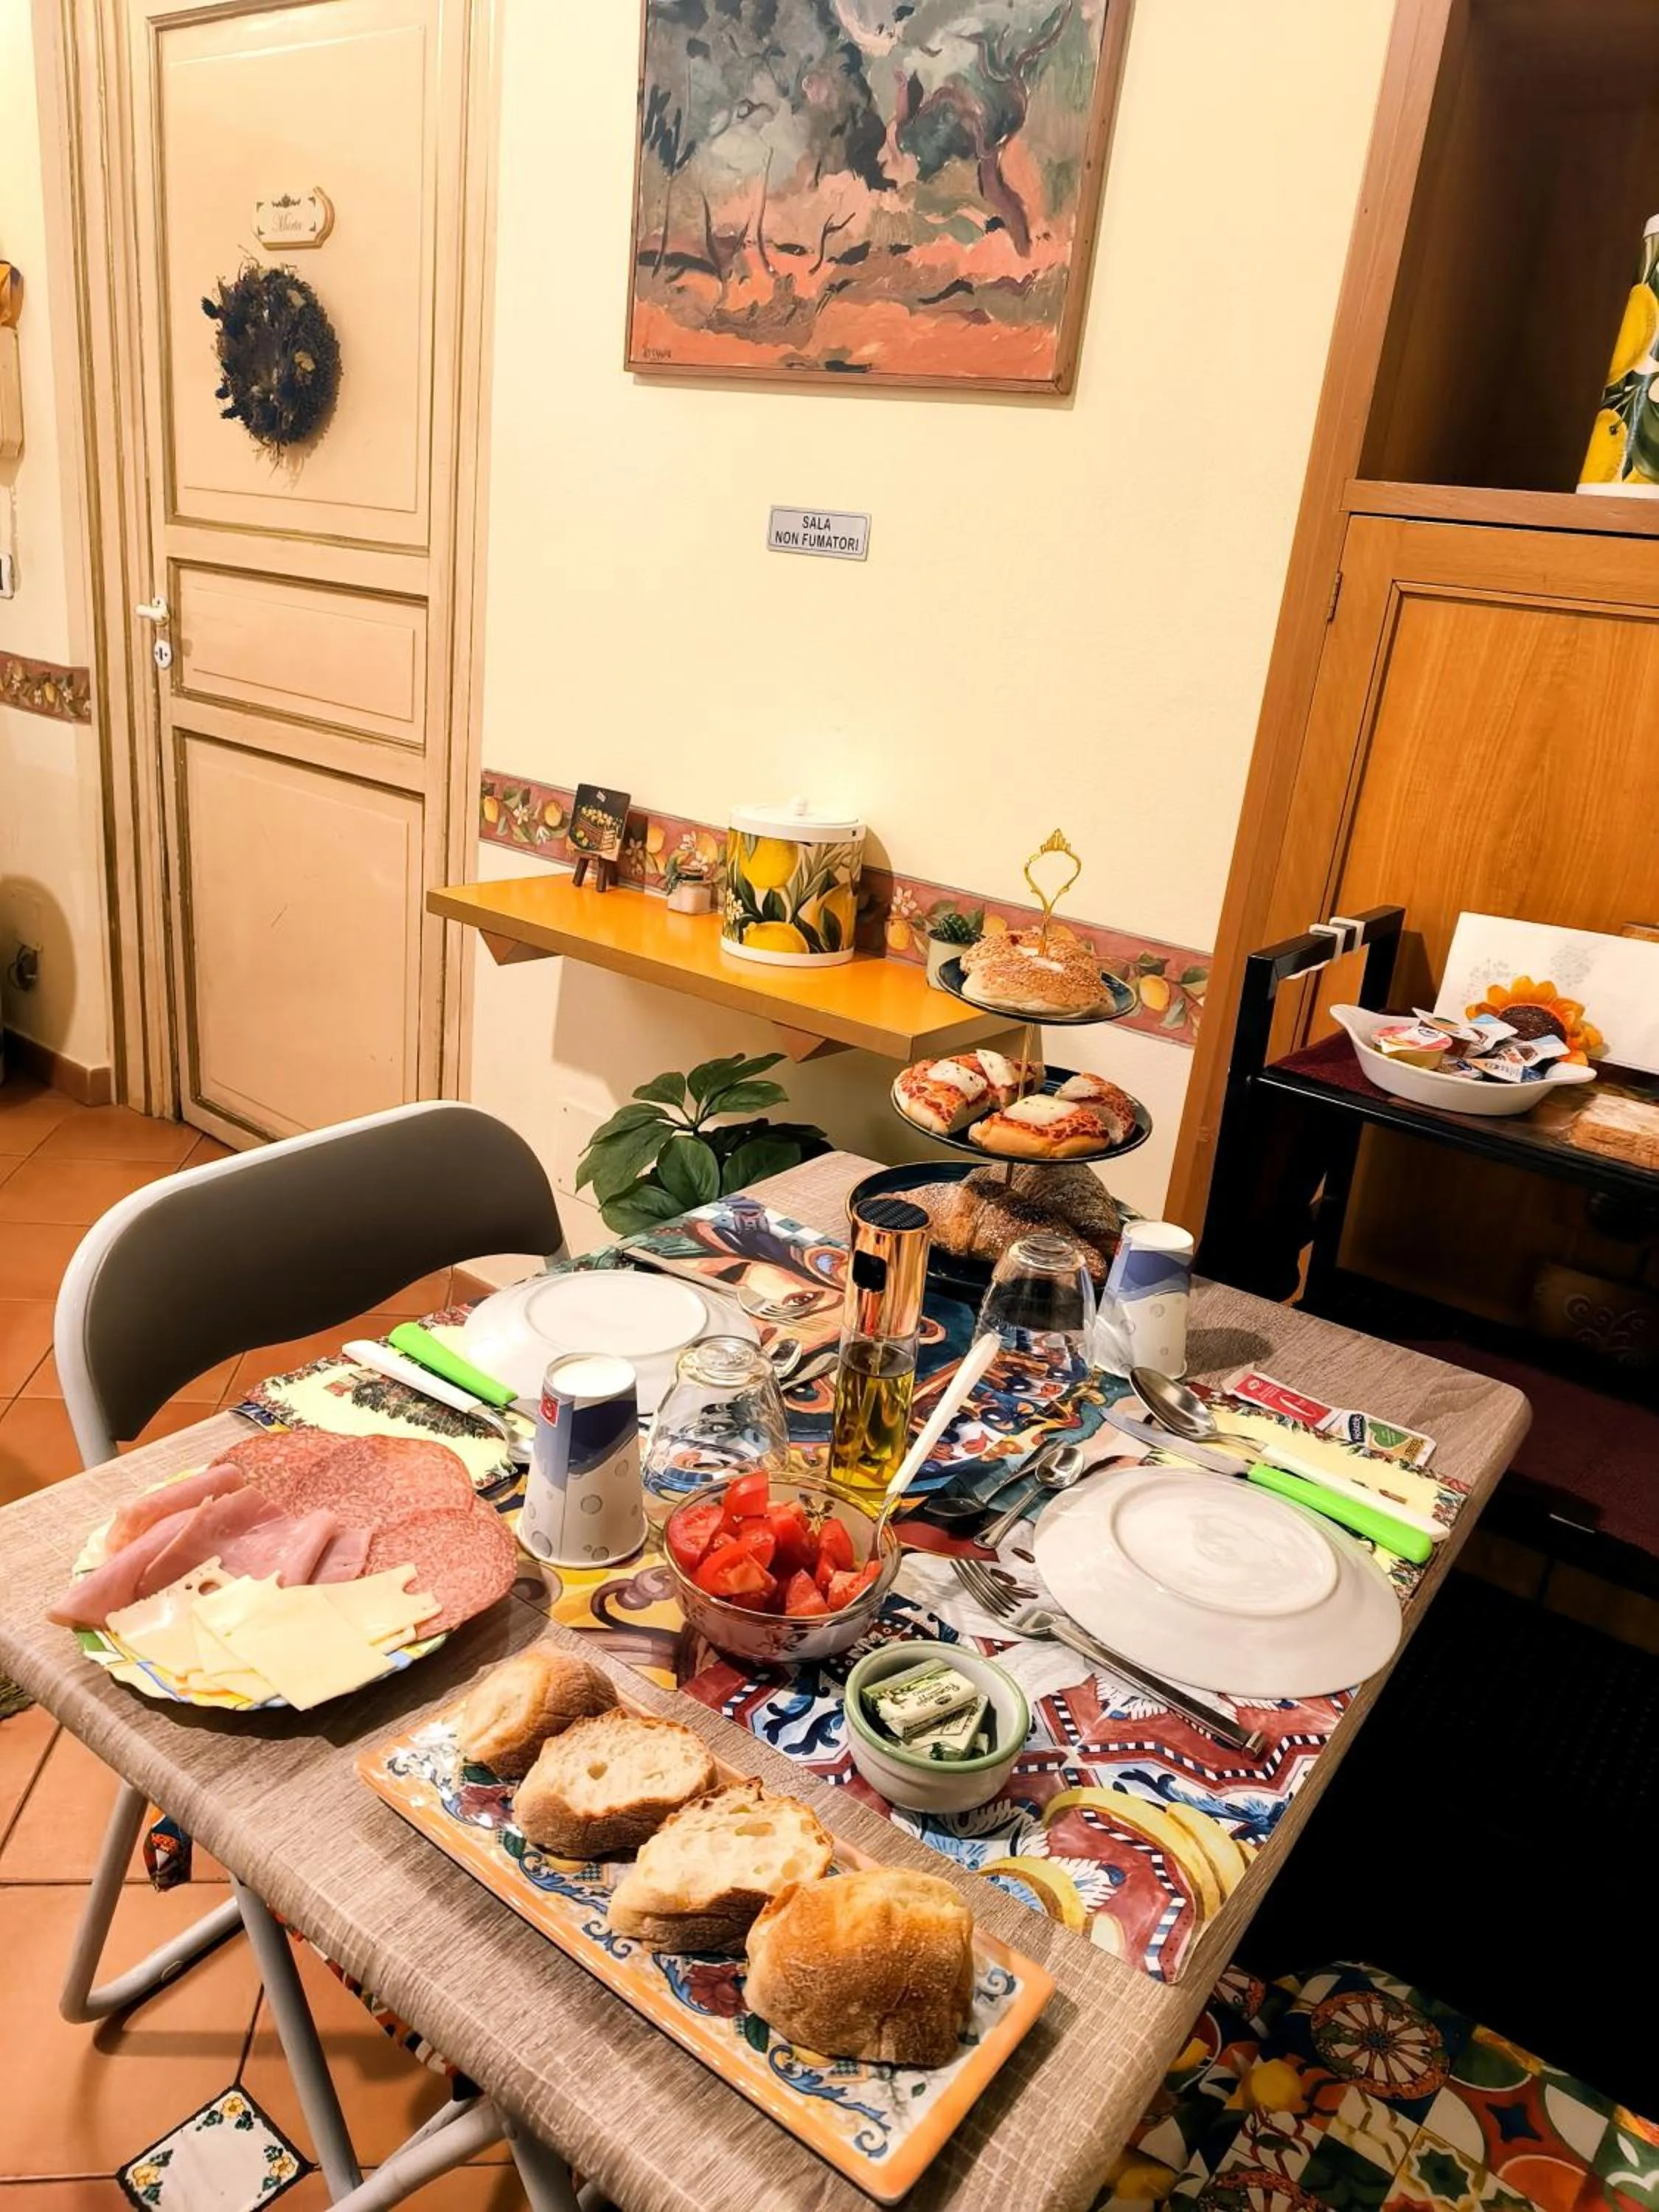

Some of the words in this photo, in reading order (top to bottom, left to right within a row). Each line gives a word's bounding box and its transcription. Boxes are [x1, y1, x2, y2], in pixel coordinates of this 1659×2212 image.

[802, 515, 831, 531] SALA
[775, 531, 799, 545] NON
[802, 533, 859, 551] FUMATORI
